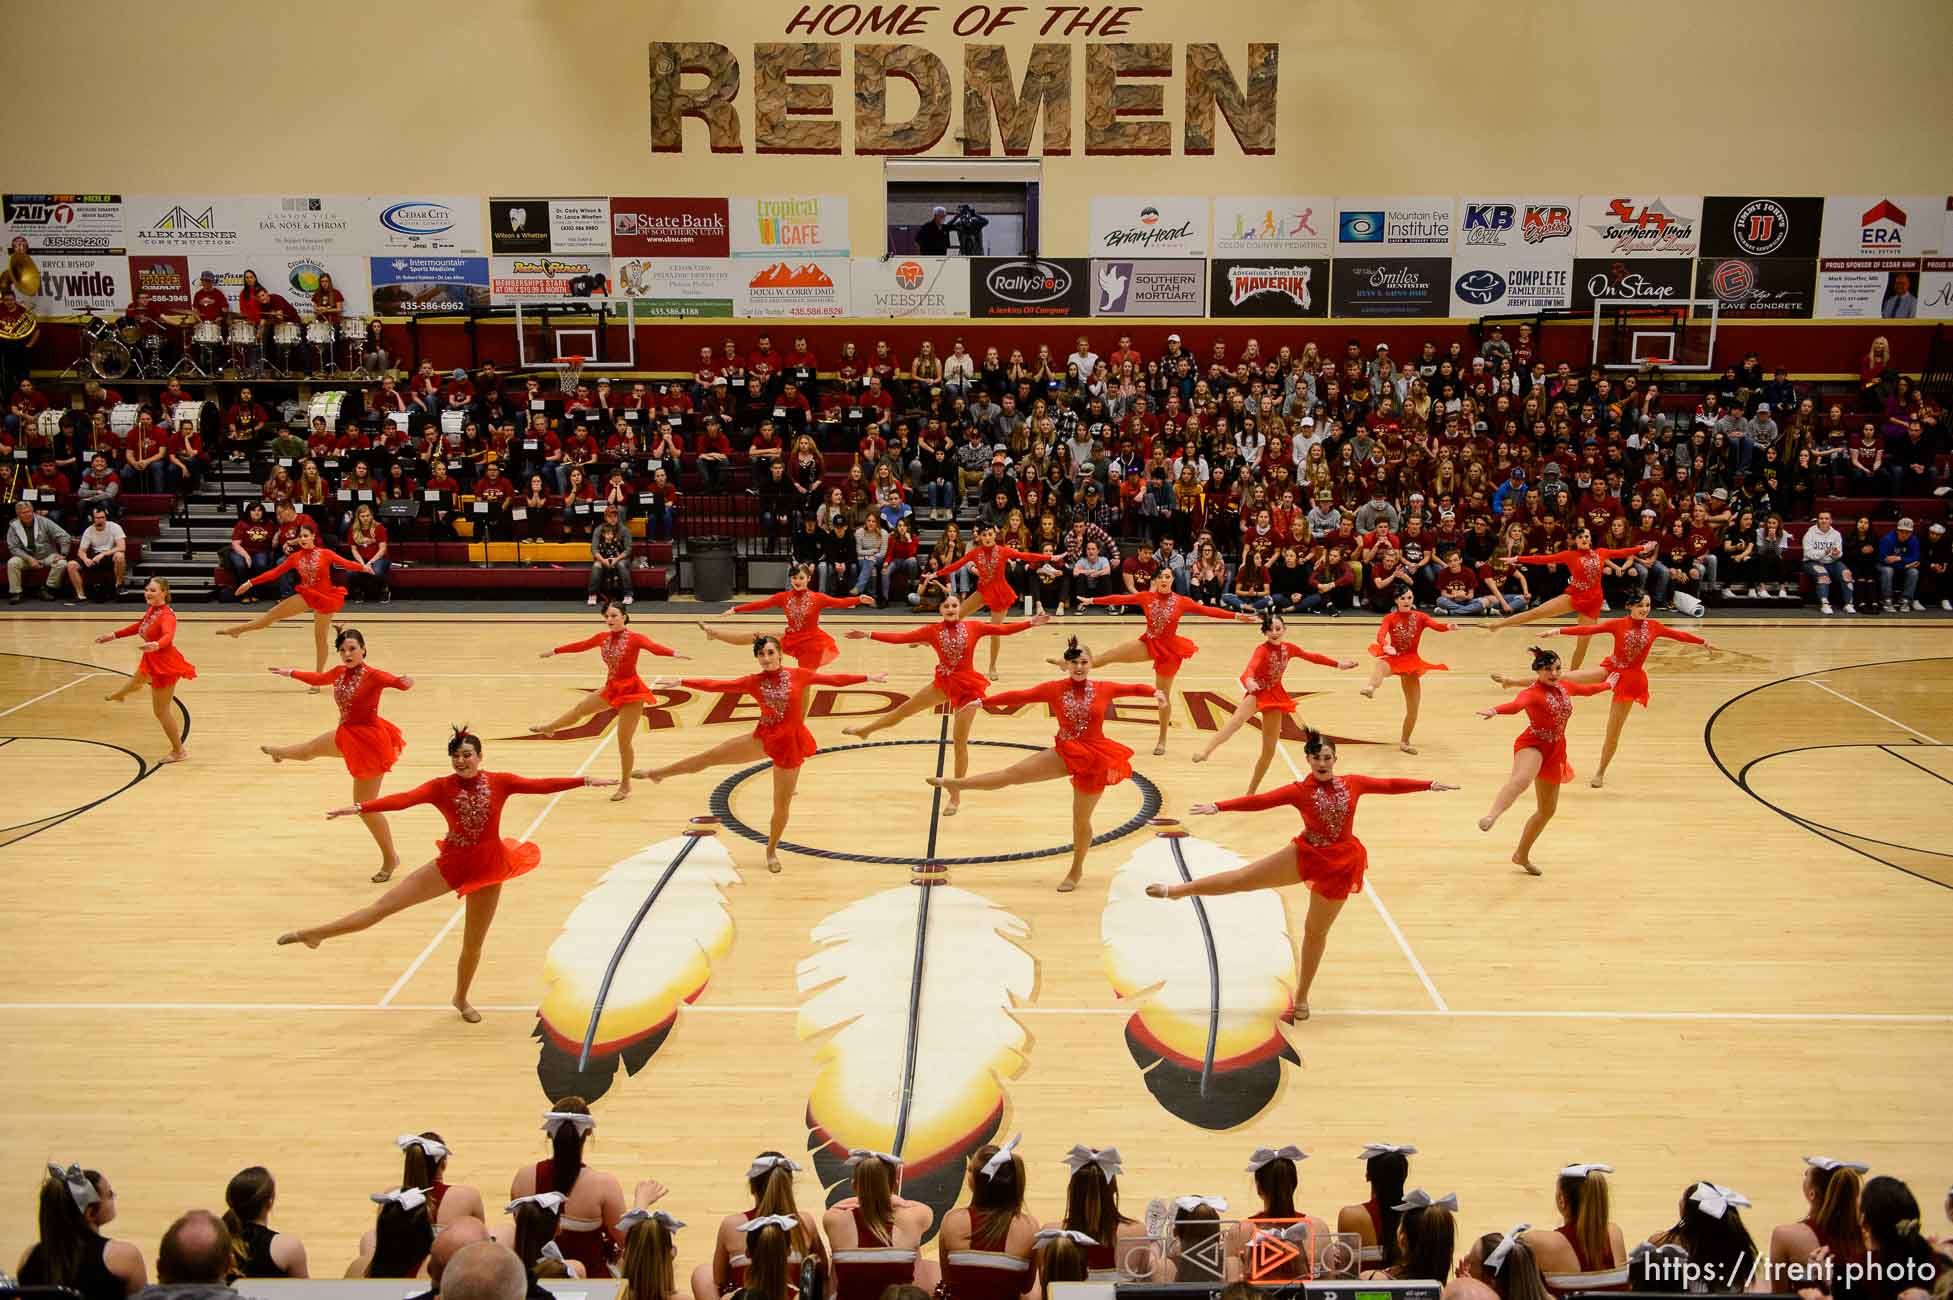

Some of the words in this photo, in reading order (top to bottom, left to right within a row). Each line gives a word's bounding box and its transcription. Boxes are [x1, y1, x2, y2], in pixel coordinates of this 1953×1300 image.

[786, 4, 941, 36] HOME
[952, 4, 1027, 36] OF
[1040, 4, 1144, 36] THE
[649, 42, 1280, 156] REDMEN
[83, 195, 111, 203] MOLD
[398, 208, 427, 219] CEDAR
[428, 208, 449, 219] CITY
[757, 198, 818, 219] tropical
[639, 213, 679, 227] State
[683, 213, 722, 227] Bank
[1388, 211, 1431, 221] Mountain
[1433, 211, 1449, 221] Eye
[1463, 204, 1516, 231] KB
[1737, 203, 1761, 228] JIMMY
[1763, 203, 1785, 228] JOHN'S
[279, 221, 302, 230] NOSE
[312, 221, 347, 230] THROAT
[650, 228, 697, 236] SOUTHERN
[1387, 221, 1449, 236] Institute
[1602, 225, 1660, 239] Southern
[1748, 215, 1774, 241] JJ
[138, 231, 174, 239] ALEX
[178, 231, 238, 239] MEISNER
[782, 224, 819, 245] CAFE
[1862, 229, 1902, 243] ERA
[409, 259, 464, 267] Intermountain
[1825, 261, 1845, 269] PROUD
[1135, 276, 1196, 284] SOUTHERN
[1369, 266, 1420, 287] Smiles
[1508, 271, 1567, 286] COMPLETE
[995, 275, 1065, 293] RallyStop
[1151, 284, 1180, 292] UTAH
[1235, 276, 1305, 301] MAVERIK
[1587, 274, 1617, 297] On
[1619, 274, 1674, 300] Stage
[750, 288, 774, 296] DOUG
[785, 288, 813, 296] CORRY
[814, 288, 834, 296] DMD
[1135, 291, 1196, 300] MORTUARY
[1508, 286, 1535, 296] FAMILY
[1536, 286, 1565, 296] DENTAL
[400, 301, 464, 311] 435-586-6962
[873, 294, 945, 306] WEBSTER
[1507, 299, 1527, 307] JEREMY
